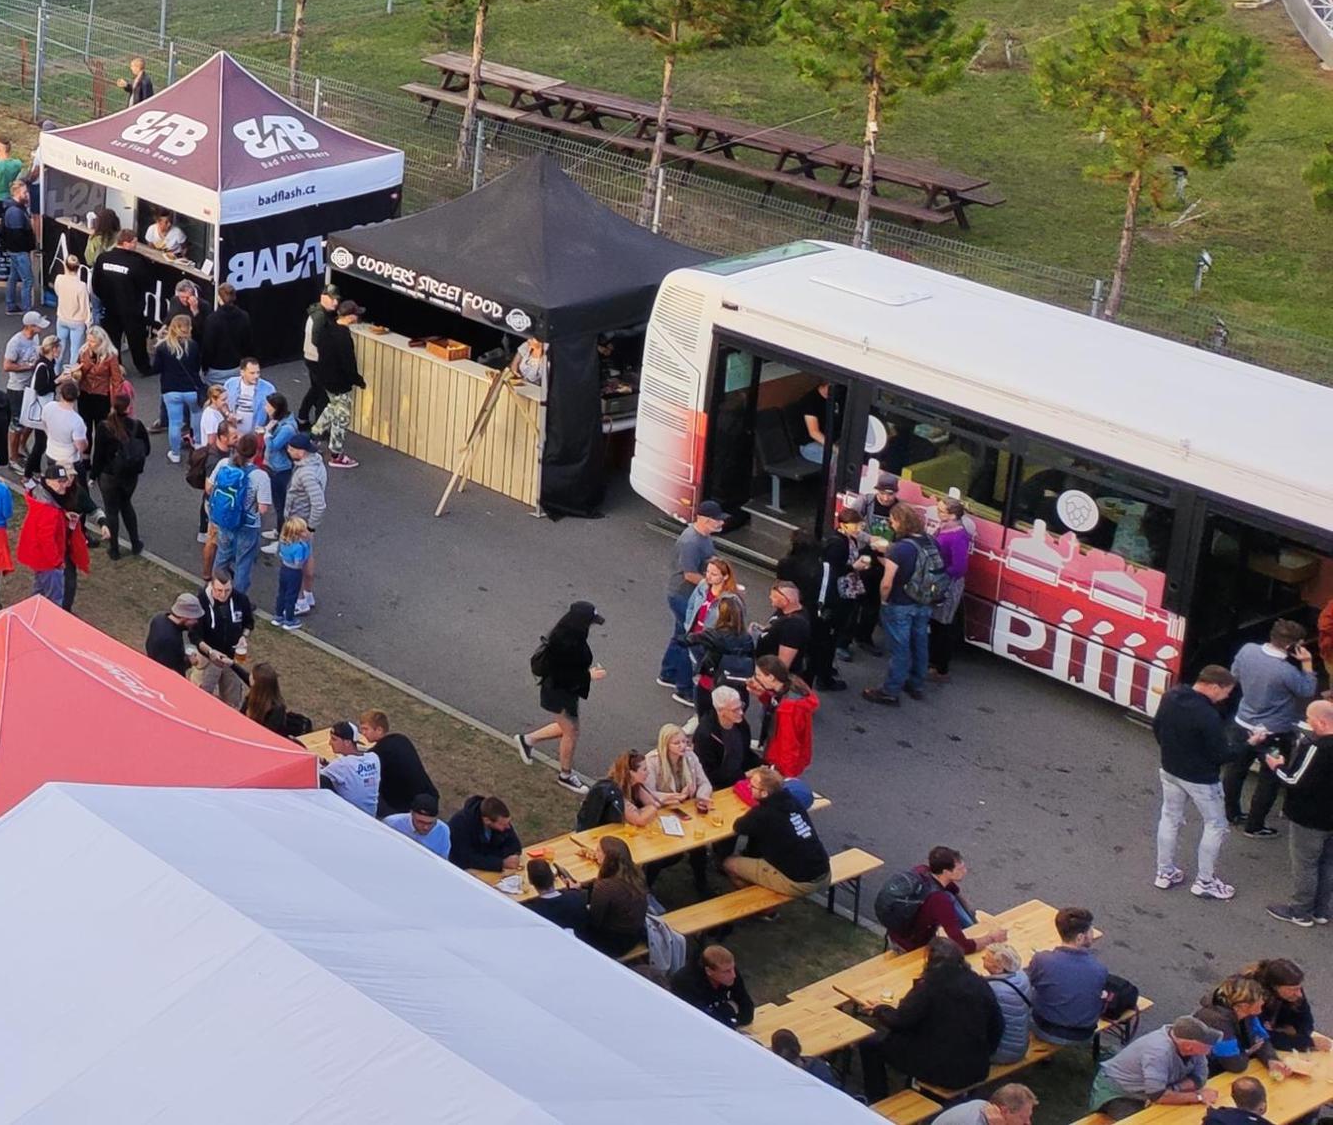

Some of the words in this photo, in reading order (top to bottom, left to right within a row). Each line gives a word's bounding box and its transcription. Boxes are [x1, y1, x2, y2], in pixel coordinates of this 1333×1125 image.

[75, 155, 131, 183] badflash.cz
[257, 185, 317, 207] badflash.cz
[417, 275, 462, 303] STREET
